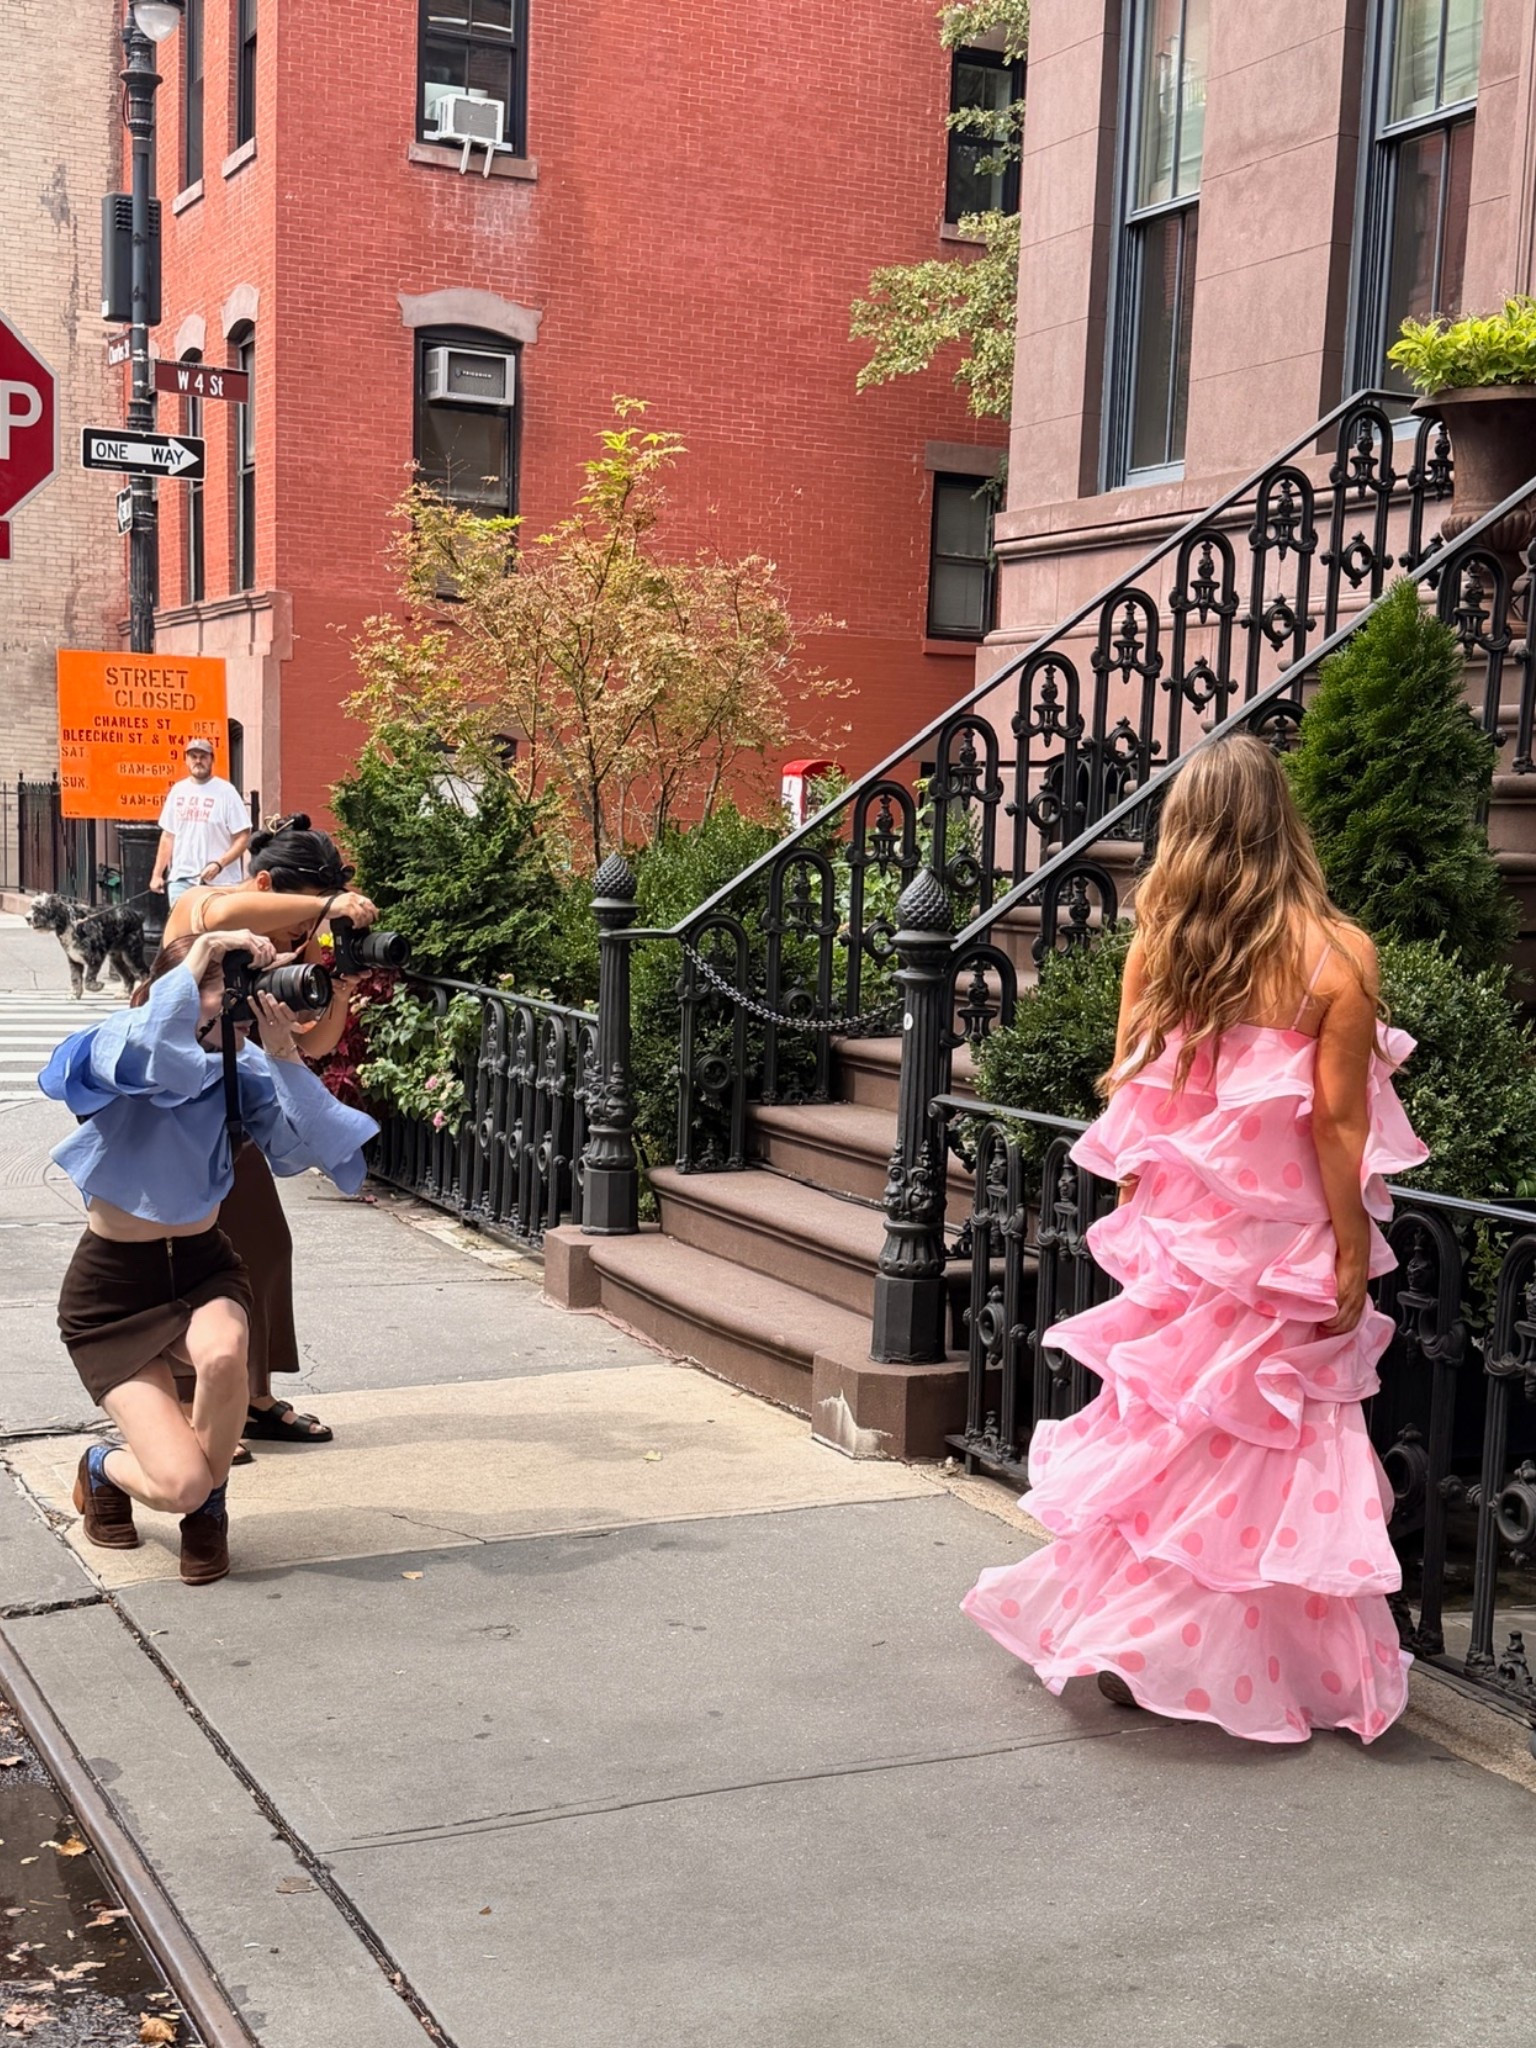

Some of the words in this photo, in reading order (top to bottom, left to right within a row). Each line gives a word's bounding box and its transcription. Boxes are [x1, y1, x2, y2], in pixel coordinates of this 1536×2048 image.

[177, 370, 189, 391] W
[194, 373, 204, 394] 4
[209, 375, 224, 397] St
[96, 442, 129, 460] ONE
[151, 447, 185, 465] WAY
[106, 667, 189, 689] STREET
[114, 690, 196, 711] CLOSED
[94, 716, 149, 729] CHARLES
[156, 719, 171, 730] ST
[63, 730, 124, 743] BLEECKER
[128, 733, 148, 745] ST.
[152, 734, 160, 745] &
[119, 763, 175, 776] 8AM-6PM
